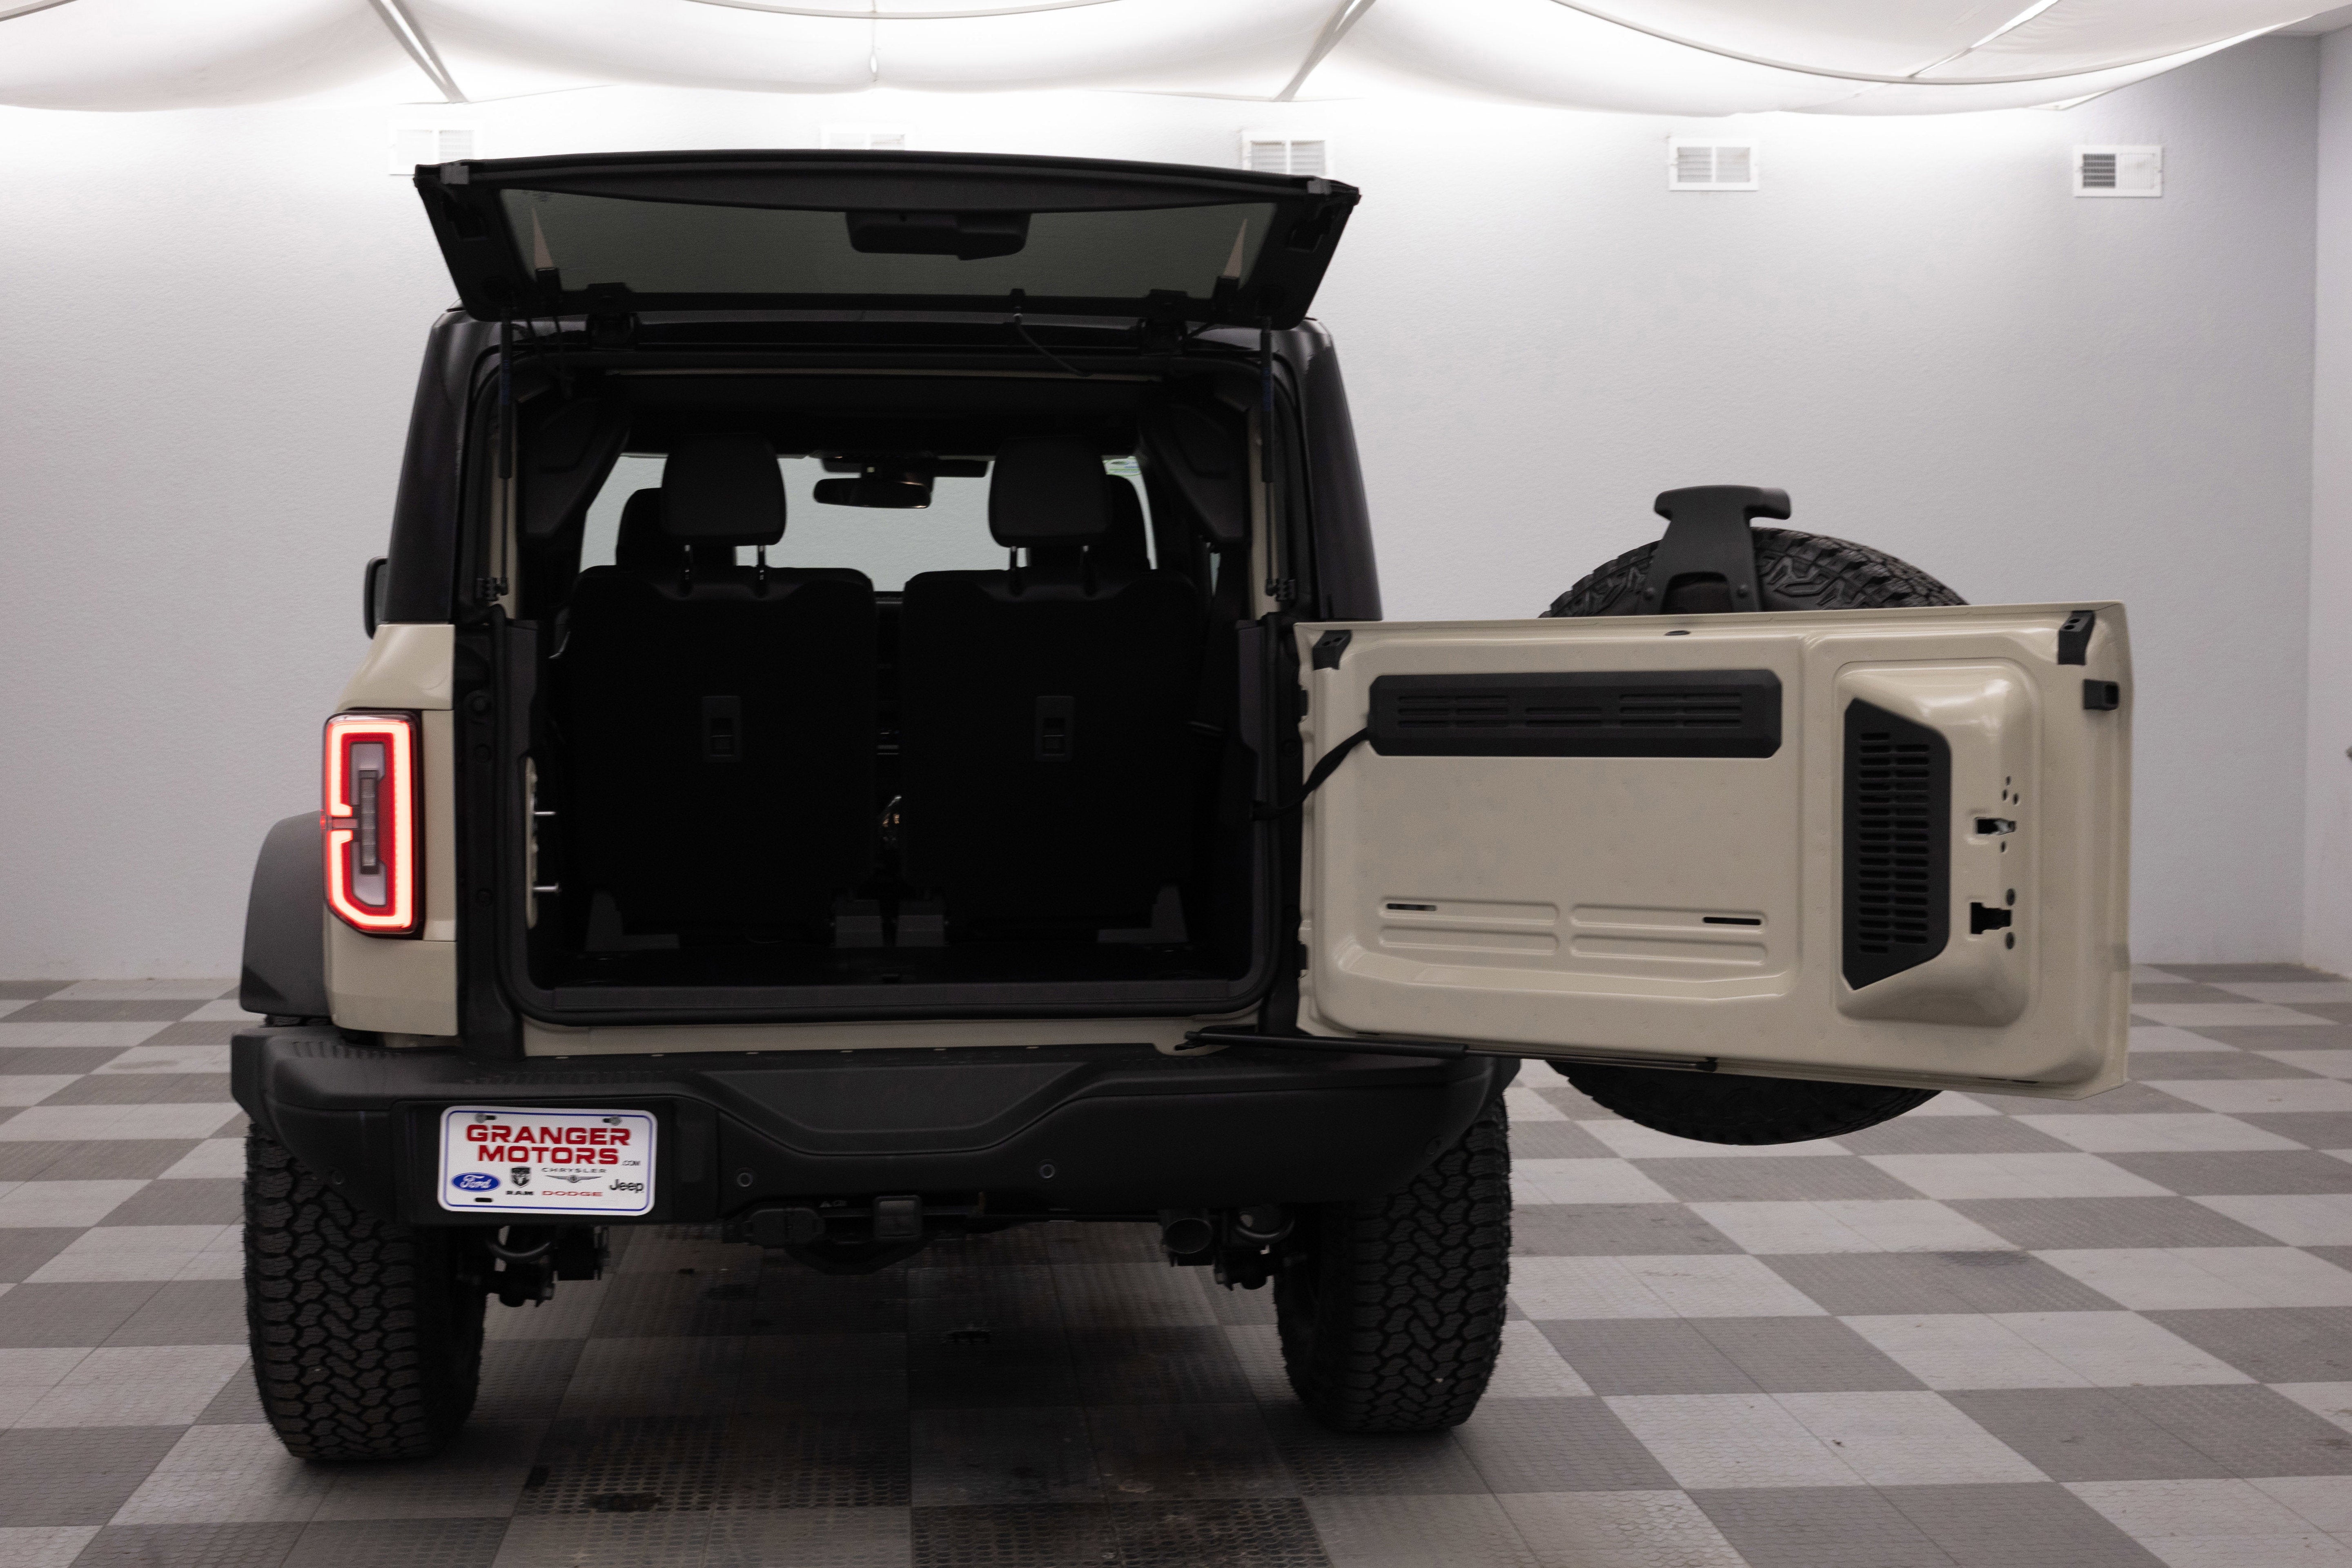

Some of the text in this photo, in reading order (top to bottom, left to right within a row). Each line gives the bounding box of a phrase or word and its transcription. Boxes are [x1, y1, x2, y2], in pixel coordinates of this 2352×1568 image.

[467, 1124, 631, 1146] GRANGER
[478, 1145, 619, 1165] MOTORS
[459, 1174, 492, 1188] Ford
[610, 1179, 644, 1194] Jeep
